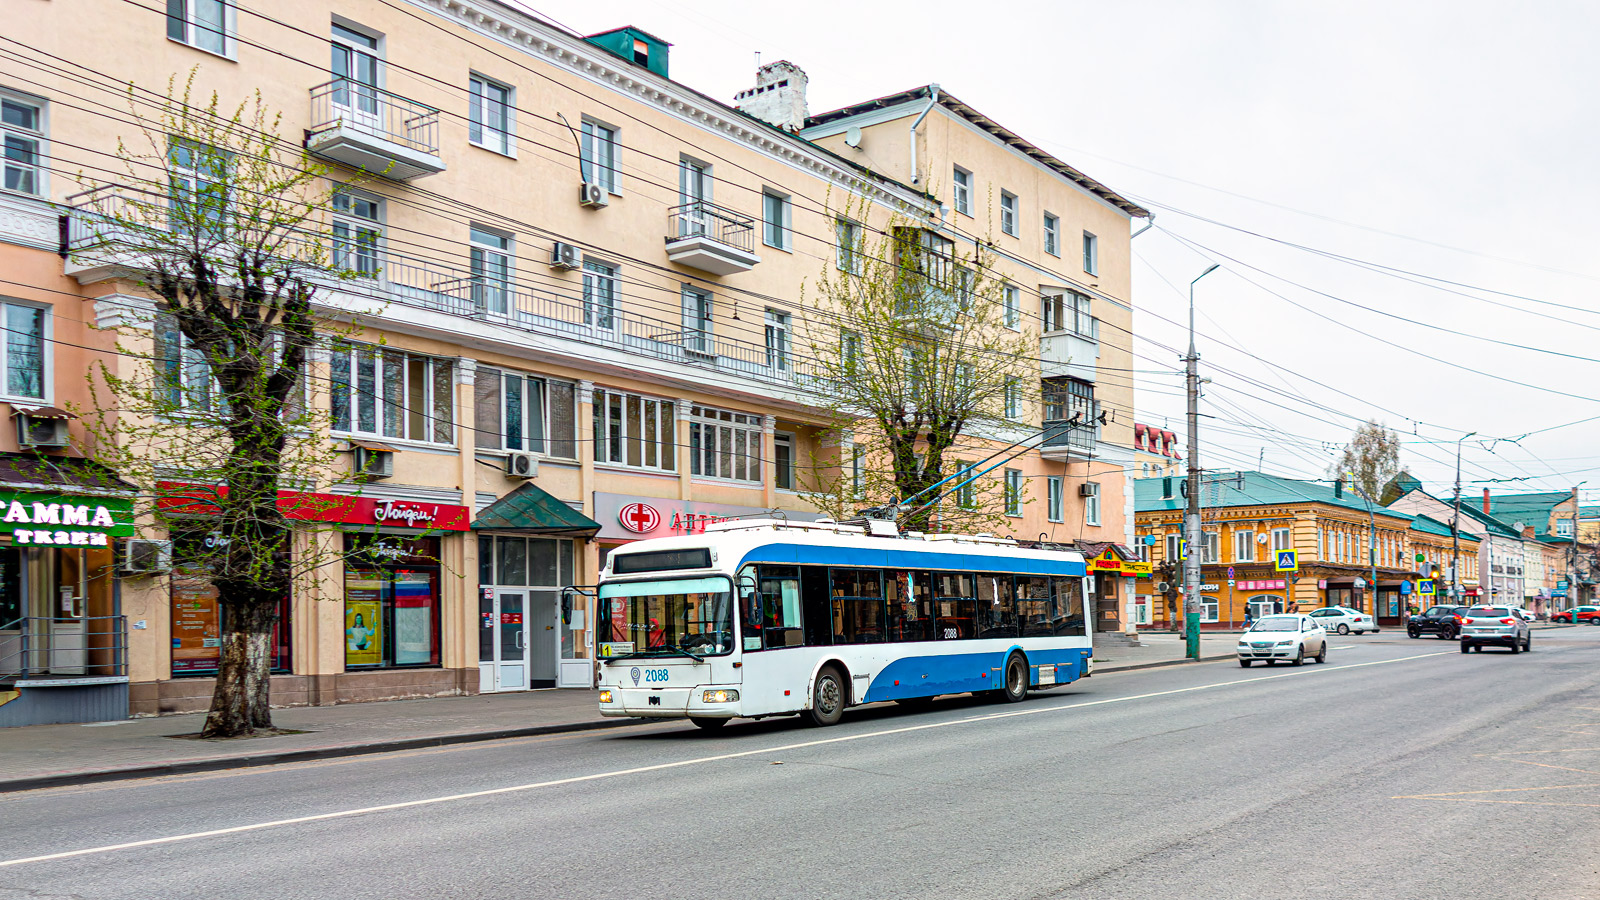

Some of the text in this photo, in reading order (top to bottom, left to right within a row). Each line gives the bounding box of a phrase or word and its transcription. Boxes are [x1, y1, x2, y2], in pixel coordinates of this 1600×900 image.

[375, 500, 438, 526] Пойдём!
[944, 628, 957, 638] 2088
[604, 645, 610, 657] 1
[645, 669, 669, 682] 2088
